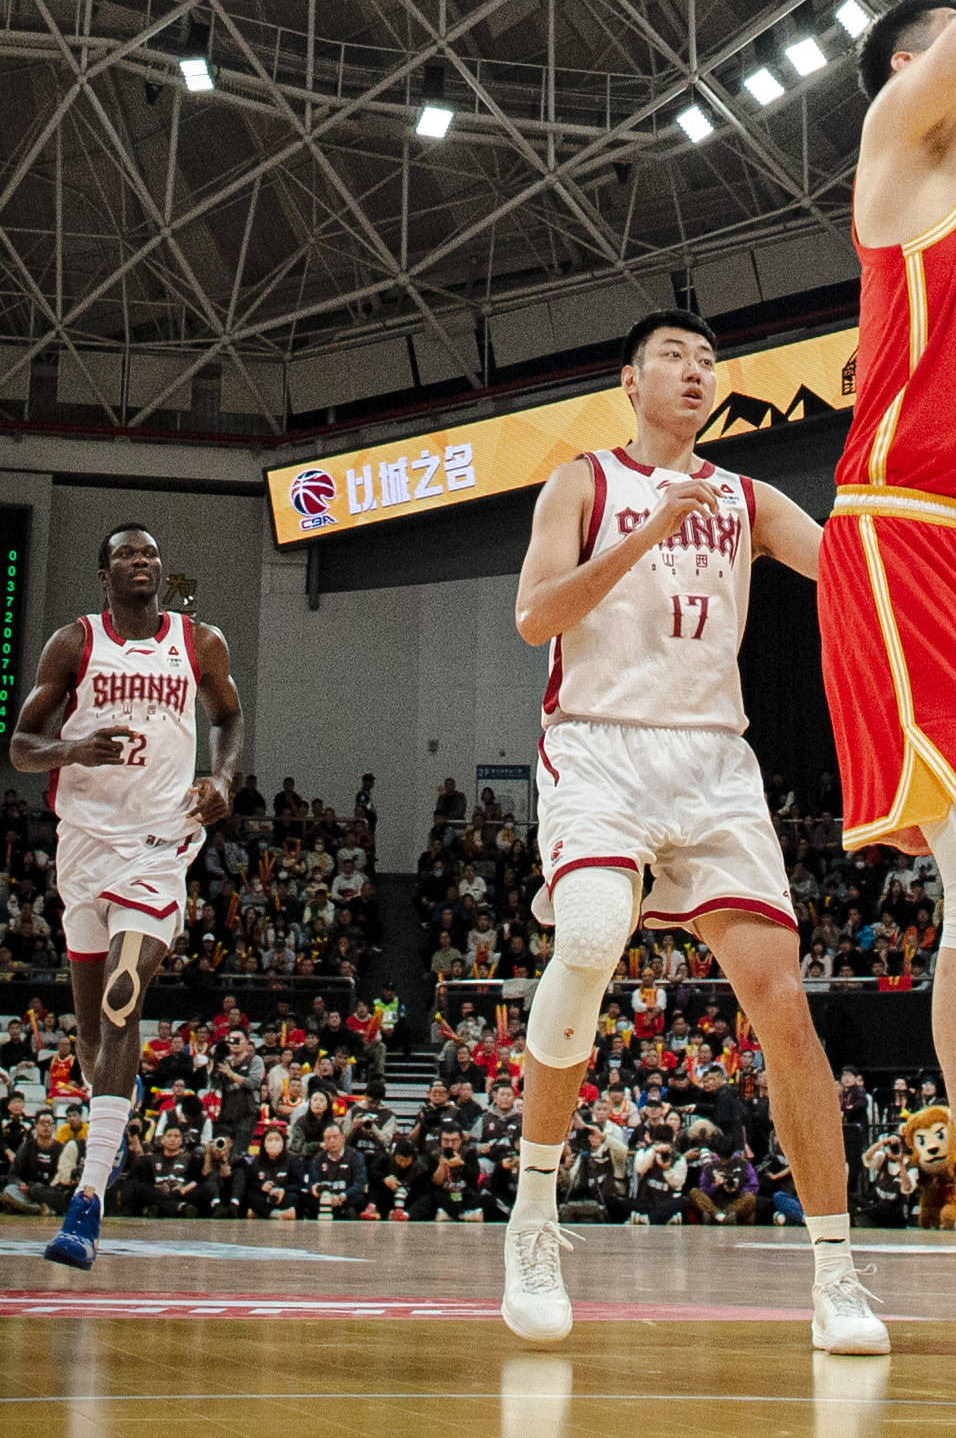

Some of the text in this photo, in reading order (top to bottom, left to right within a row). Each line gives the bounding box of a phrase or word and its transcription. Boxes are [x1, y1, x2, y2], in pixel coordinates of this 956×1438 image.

[345, 443, 477, 516] 以城之名
[300, 515, 338, 532] CBA
[8, 550, 17, 561] 0
[7, 565, 16, 576] 0
[6, 580, 15, 592] 3
[6, 596, 14, 607] 7
[4, 611, 13, 623] 2
[670, 594, 709, 640] 17
[3, 627, 12, 638] 0
[2, 643, 11, 654] 0
[2, 658, 10, 669] 7
[2, 674, 15, 685] 11
[93, 671, 190, 716] SHANXI
